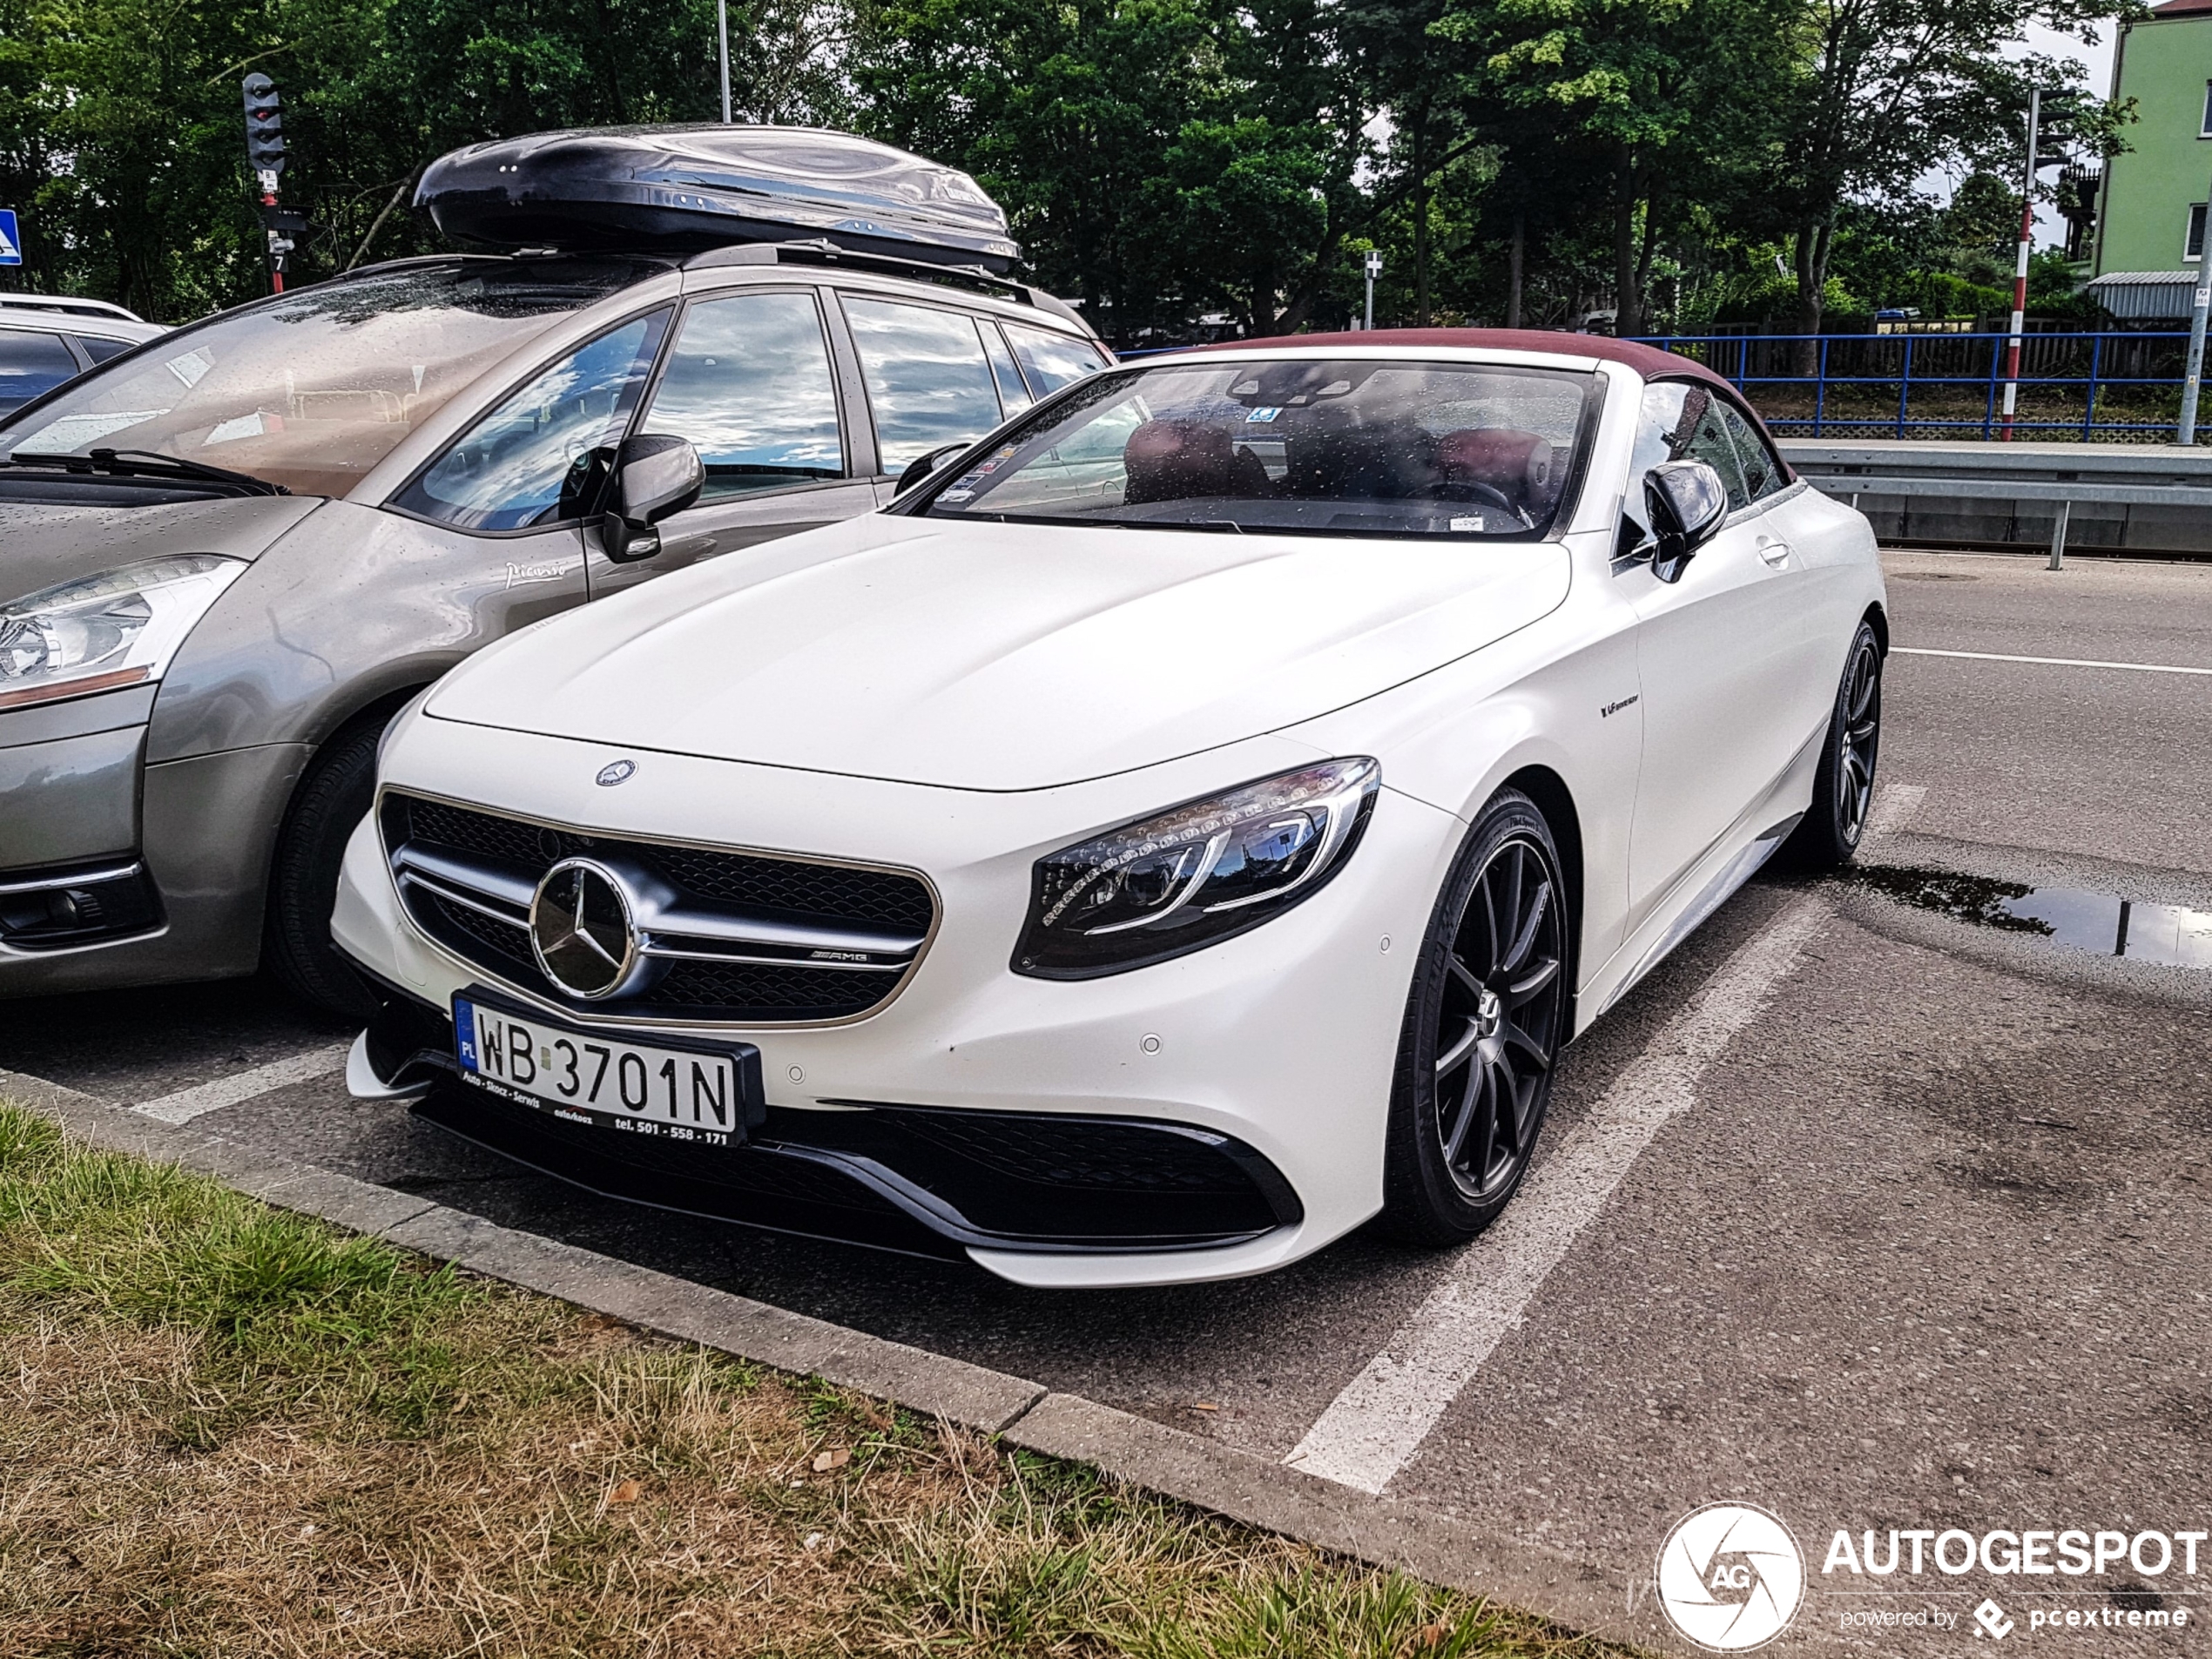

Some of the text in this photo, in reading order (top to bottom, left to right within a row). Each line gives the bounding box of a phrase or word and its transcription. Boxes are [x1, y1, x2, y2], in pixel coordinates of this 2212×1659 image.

[274, 255, 284, 271] 7
[506, 562, 565, 590] Picasso
[827, 951, 868, 962] AMG
[462, 1041, 475, 1059] PL
[463, 1071, 481, 1086] Auto
[487, 1080, 508, 1097] Skocz
[513, 1091, 541, 1109] Serwis
[554, 1038, 727, 1127] 3701N
[615, 1118, 635, 1132] tel.
[637, 1122, 659, 1136] 501
[670, 1127, 694, 1141] 558
[705, 1132, 728, 1146] 171
